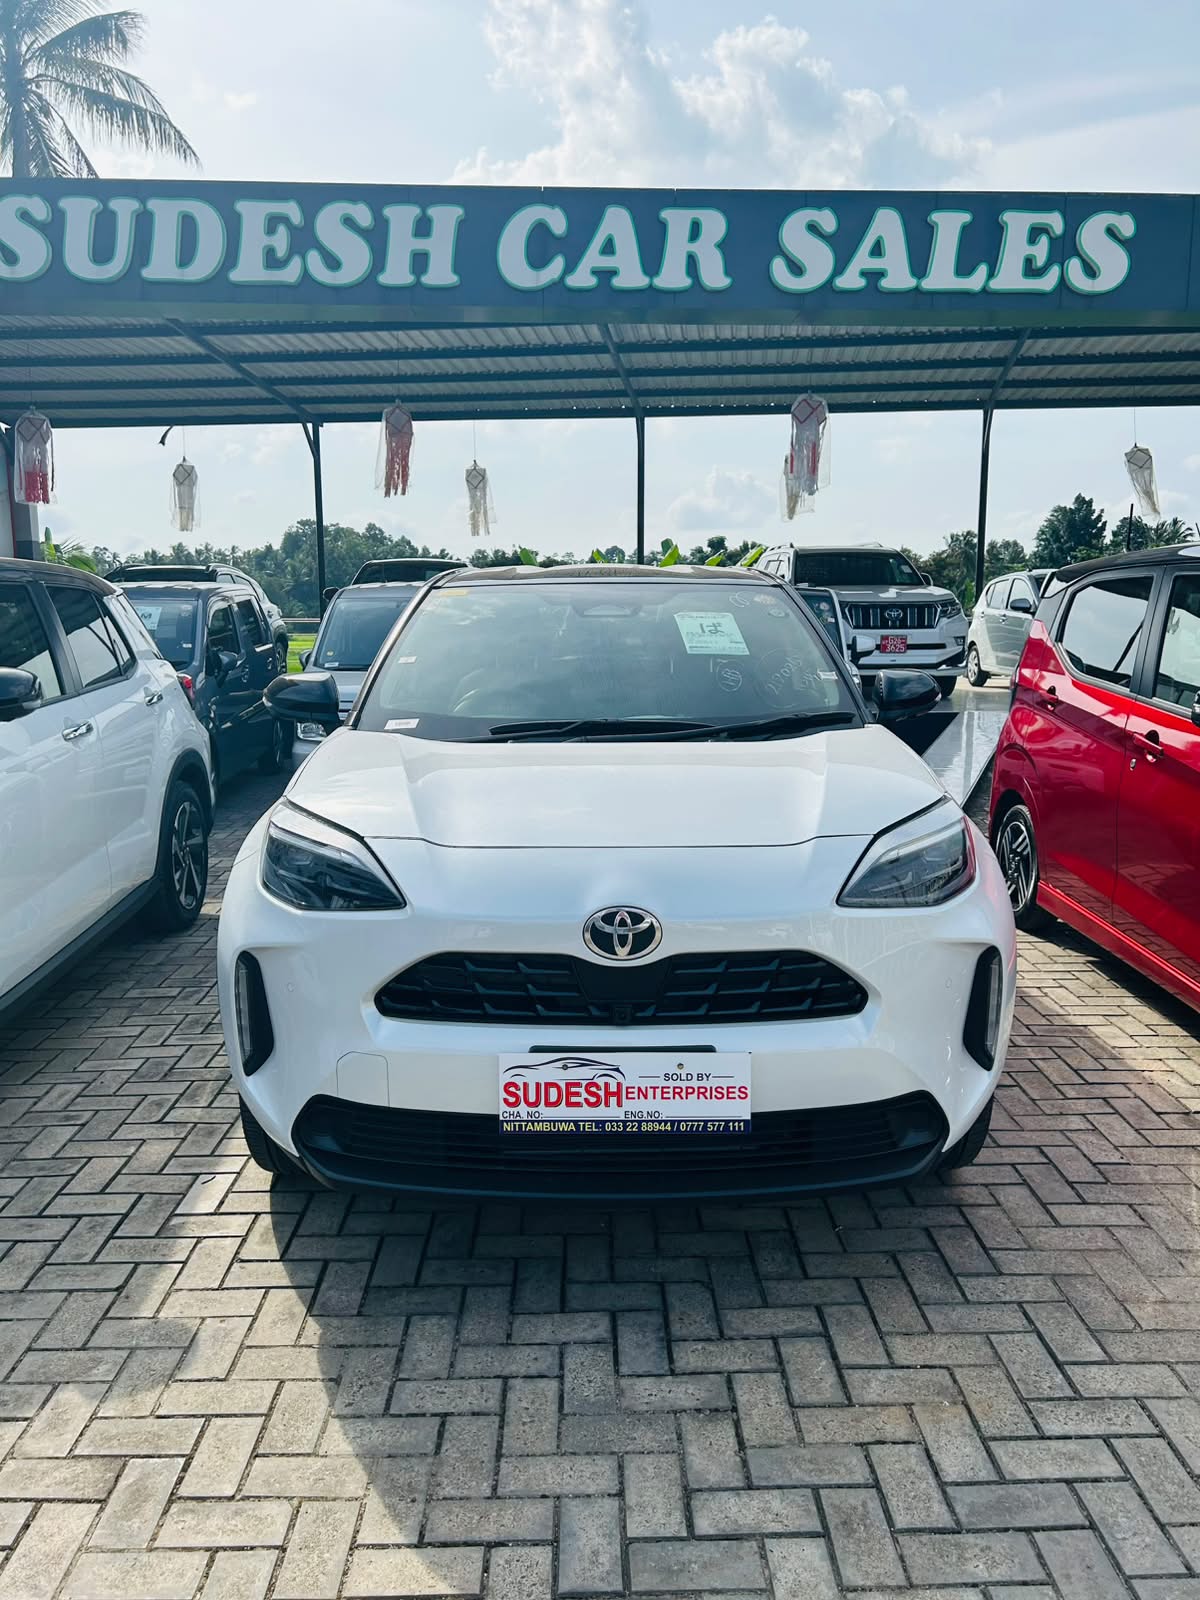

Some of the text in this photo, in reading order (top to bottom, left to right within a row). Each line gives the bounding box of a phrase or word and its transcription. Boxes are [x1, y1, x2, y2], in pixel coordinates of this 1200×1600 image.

[0, 194, 1137, 295] SUDESH CAR SALES
[663, 1073, 712, 1082] SOLD BY
[503, 1081, 749, 1108] SUDESH ENTERPRISES
[501, 1111, 544, 1119] CHA. NO:
[503, 1122, 576, 1132] NITTAMBUWA
[578, 1122, 602, 1132] TEL:
[605, 1122, 624, 1132] 033
[626, 1122, 638, 1131] 22
[641, 1122, 672, 1131] 88944
[680, 1122, 704, 1131] 0777
[707, 1122, 725, 1131] 577
[728, 1122, 744, 1131] 111
